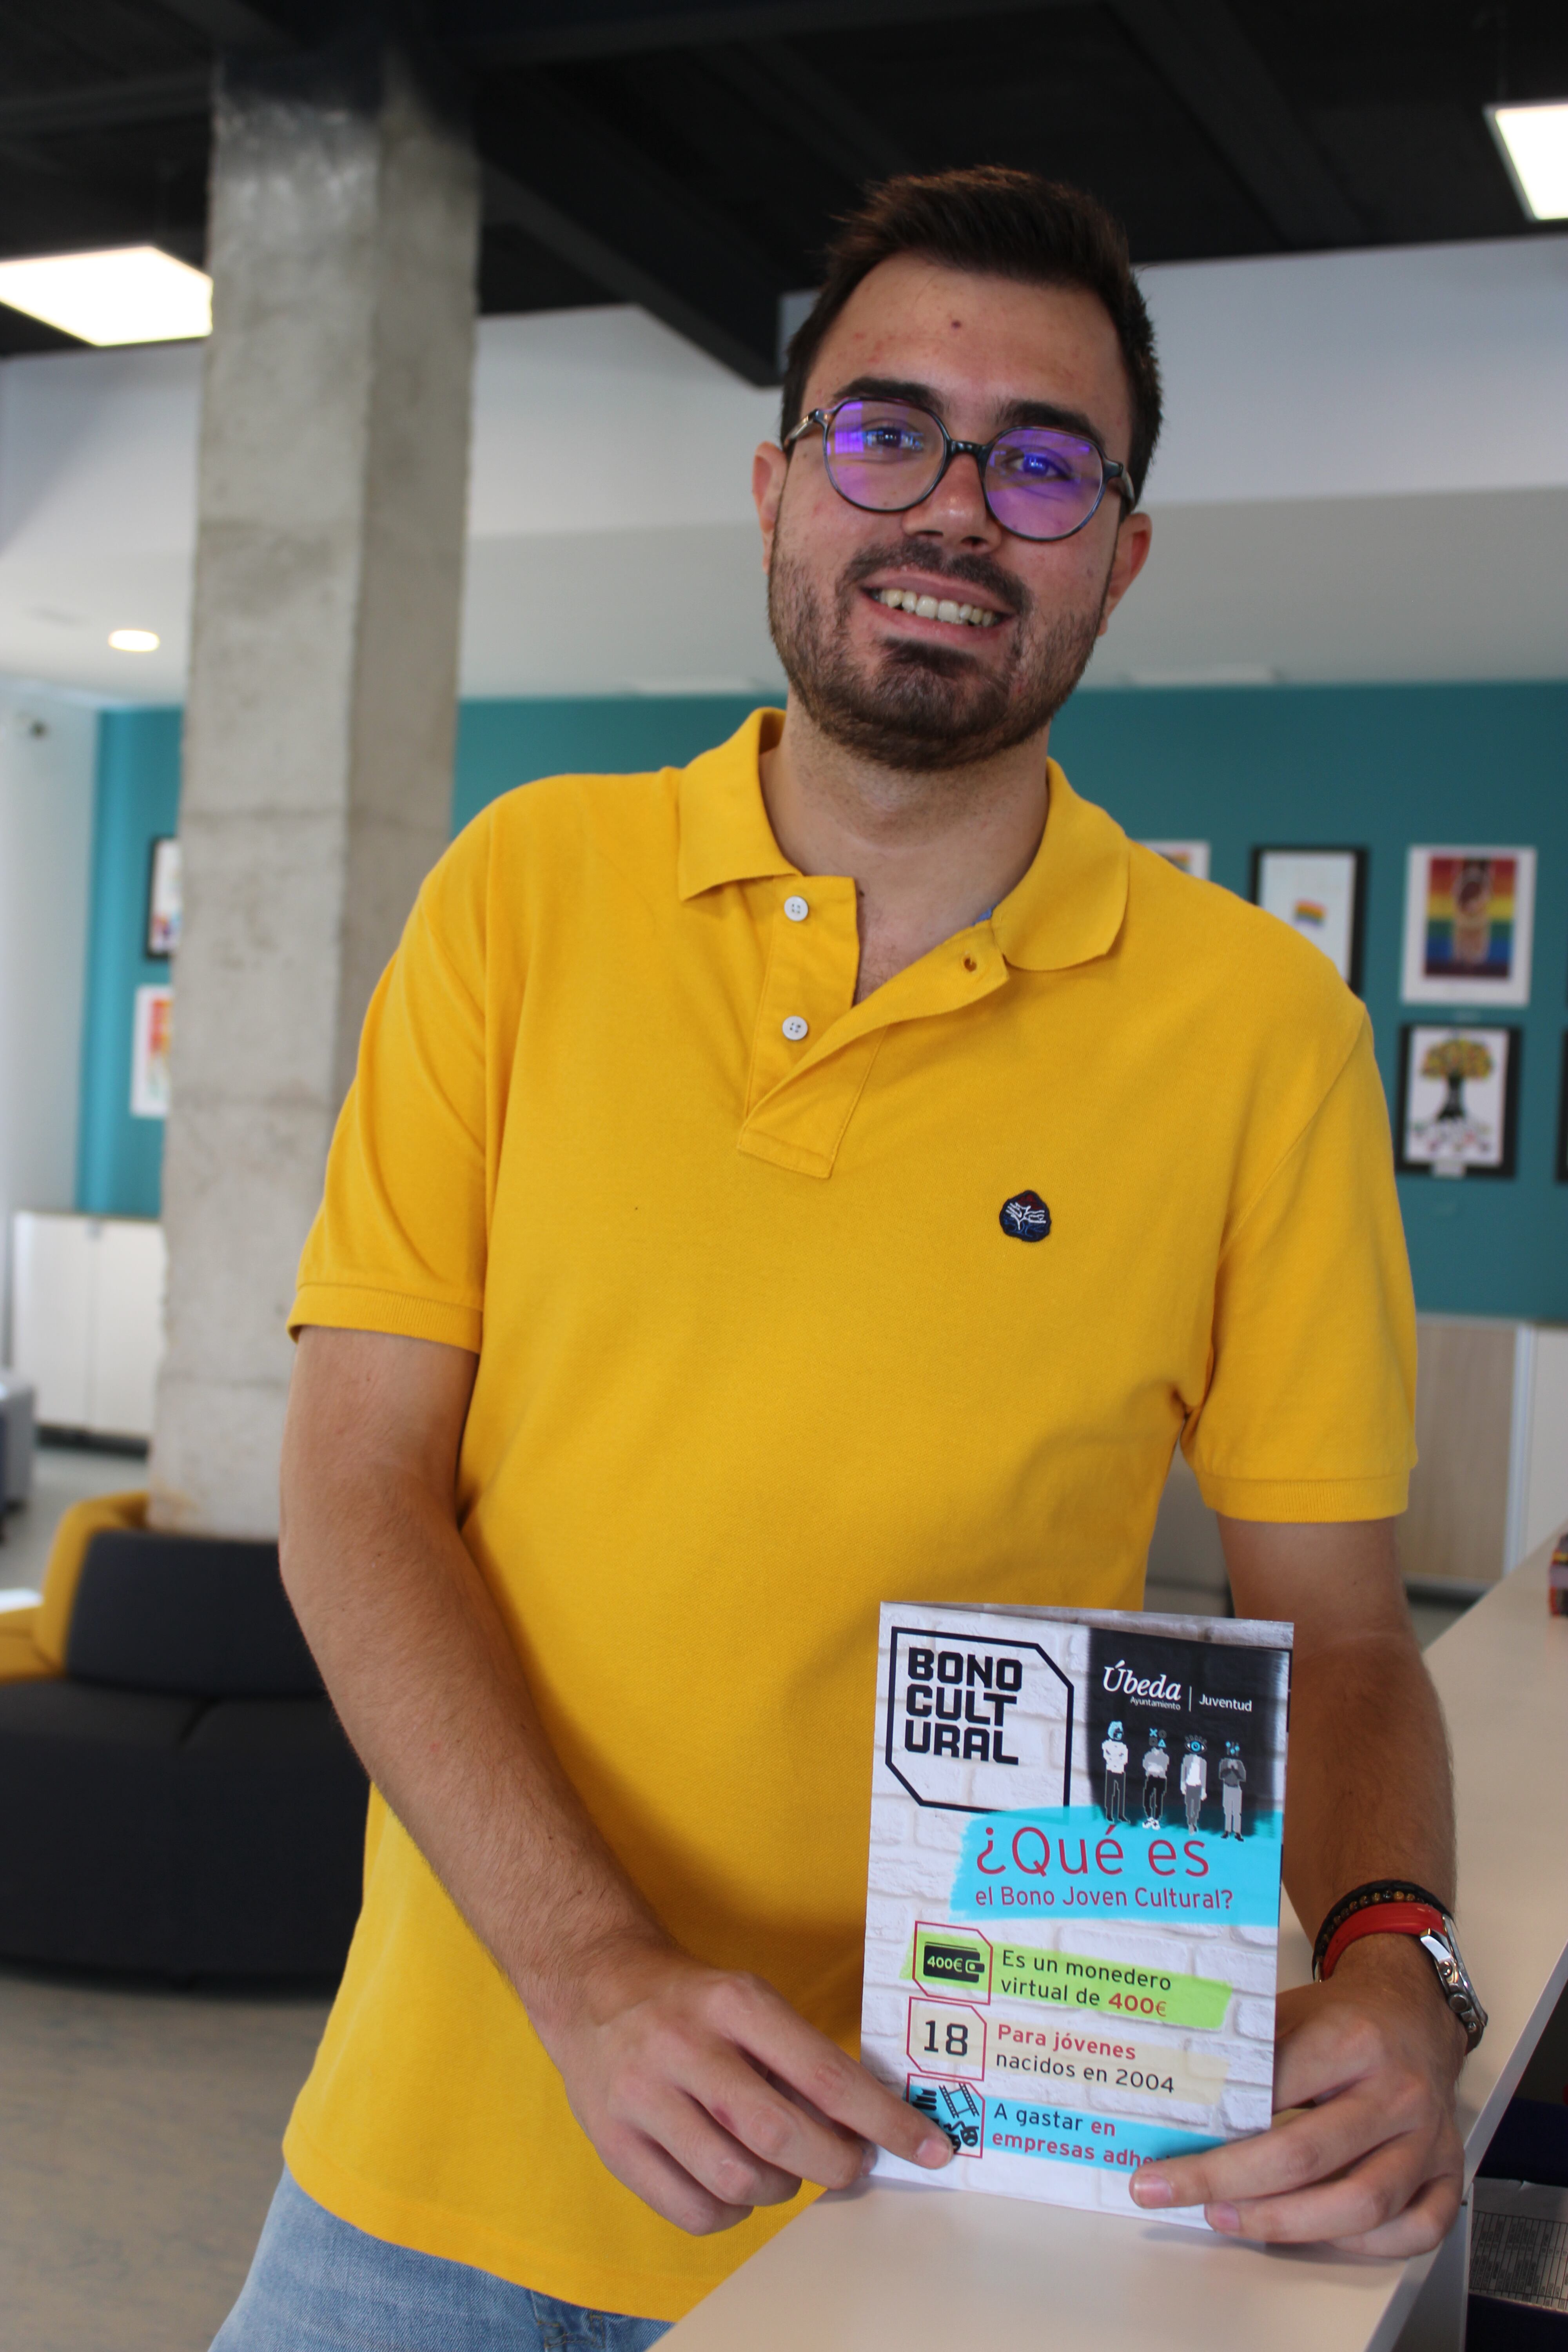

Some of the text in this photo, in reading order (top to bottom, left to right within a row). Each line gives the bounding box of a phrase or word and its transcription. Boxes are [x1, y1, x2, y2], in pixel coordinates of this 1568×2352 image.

[908, 1647, 1022, 1692] BONO
[1103, 1659, 1181, 1700] Úbeda
[906, 1684, 1017, 1727] CULT
[1130, 1696, 1181, 1710] Ayuntamiento
[1199, 1694, 1252, 1712] Juventud
[905, 1719, 1018, 1765] URAL
[977, 1824, 1209, 1877] ¿Qué es
[976, 1886, 1233, 1909] el Bono Joven Cultural?
[927, 1956, 963, 1973] 400€
[1003, 1950, 1171, 1991] Es un monedero
[1001, 1978, 1167, 2017] virtual de 400€
[924, 2020, 968, 2056] 18
[998, 2024, 1136, 2060] Para jóvenes
[996, 2054, 1174, 2093] nacidos en 2004
[994, 2103, 1115, 2136] A gastar en
[992, 2132, 1095, 2160] empresas
